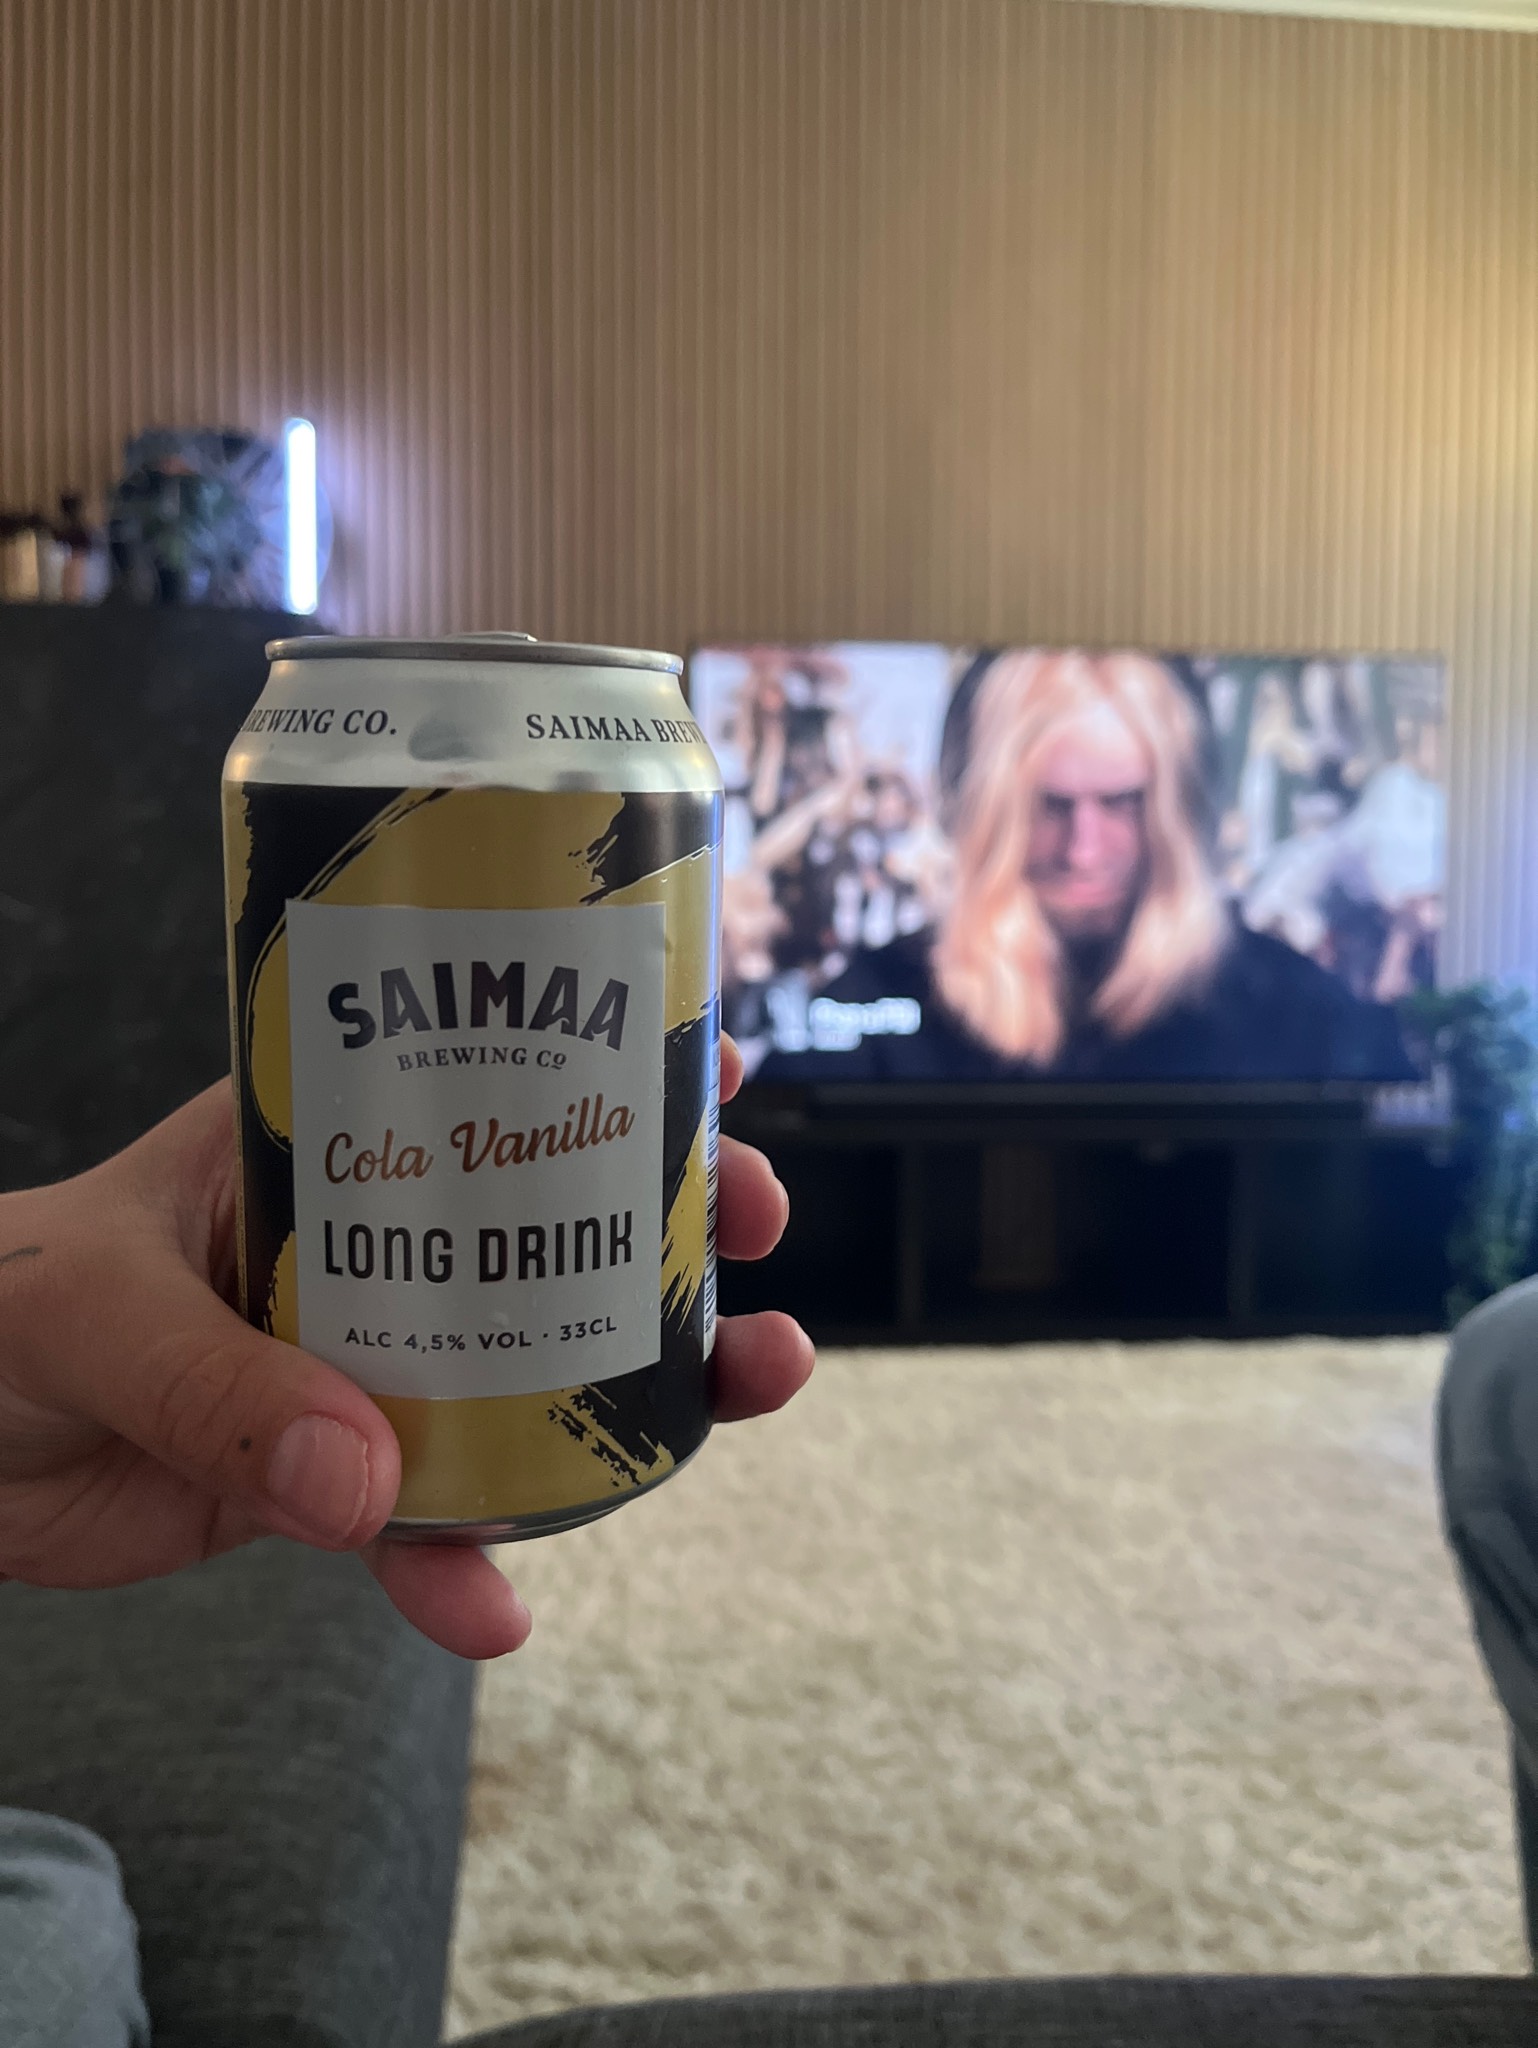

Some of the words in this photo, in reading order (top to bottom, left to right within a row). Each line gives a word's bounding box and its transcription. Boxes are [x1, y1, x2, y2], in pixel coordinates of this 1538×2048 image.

[342, 709, 397, 736] CO.
[526, 713, 653, 742] SAIMAA
[650, 718, 707, 744] BREW
[327, 961, 630, 1051] SAIMAA
[396, 1046, 528, 1072] BREWING
[325, 1128, 434, 1184] Cola
[450, 1093, 635, 1173] Vanilla
[324, 1219, 454, 1284] LONG
[479, 1210, 633, 1283] DRINK
[345, 1327, 392, 1348] ALC
[403, 1333, 466, 1354] 4,5%
[478, 1328, 533, 1350] VOL
[559, 1315, 617, 1342] 33CL
